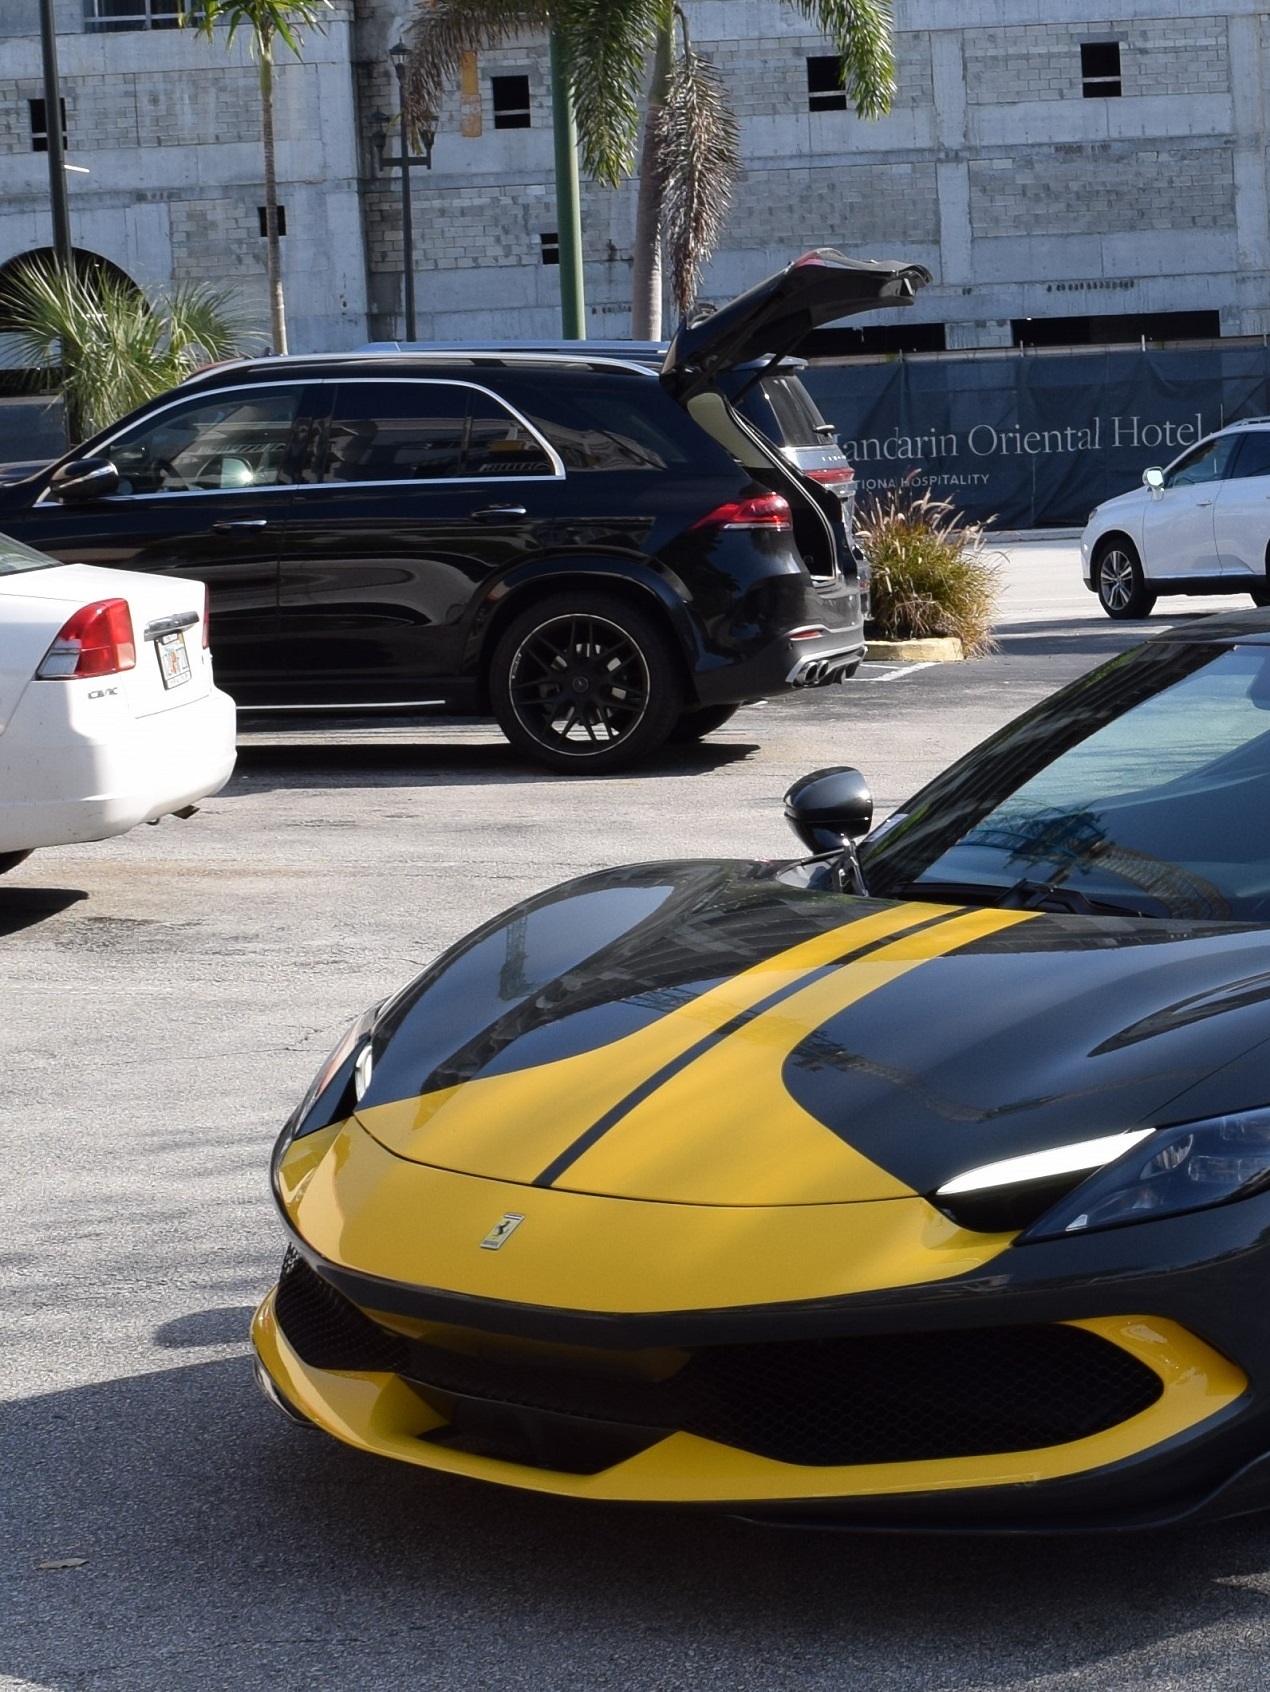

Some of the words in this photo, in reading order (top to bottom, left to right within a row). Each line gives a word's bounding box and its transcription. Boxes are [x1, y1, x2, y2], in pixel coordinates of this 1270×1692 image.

[833, 427, 960, 463] andarin
[968, 416, 1102, 456] Oriental
[1111, 413, 1202, 448] Hotel
[901, 474, 990, 488] HOSPITALITY
